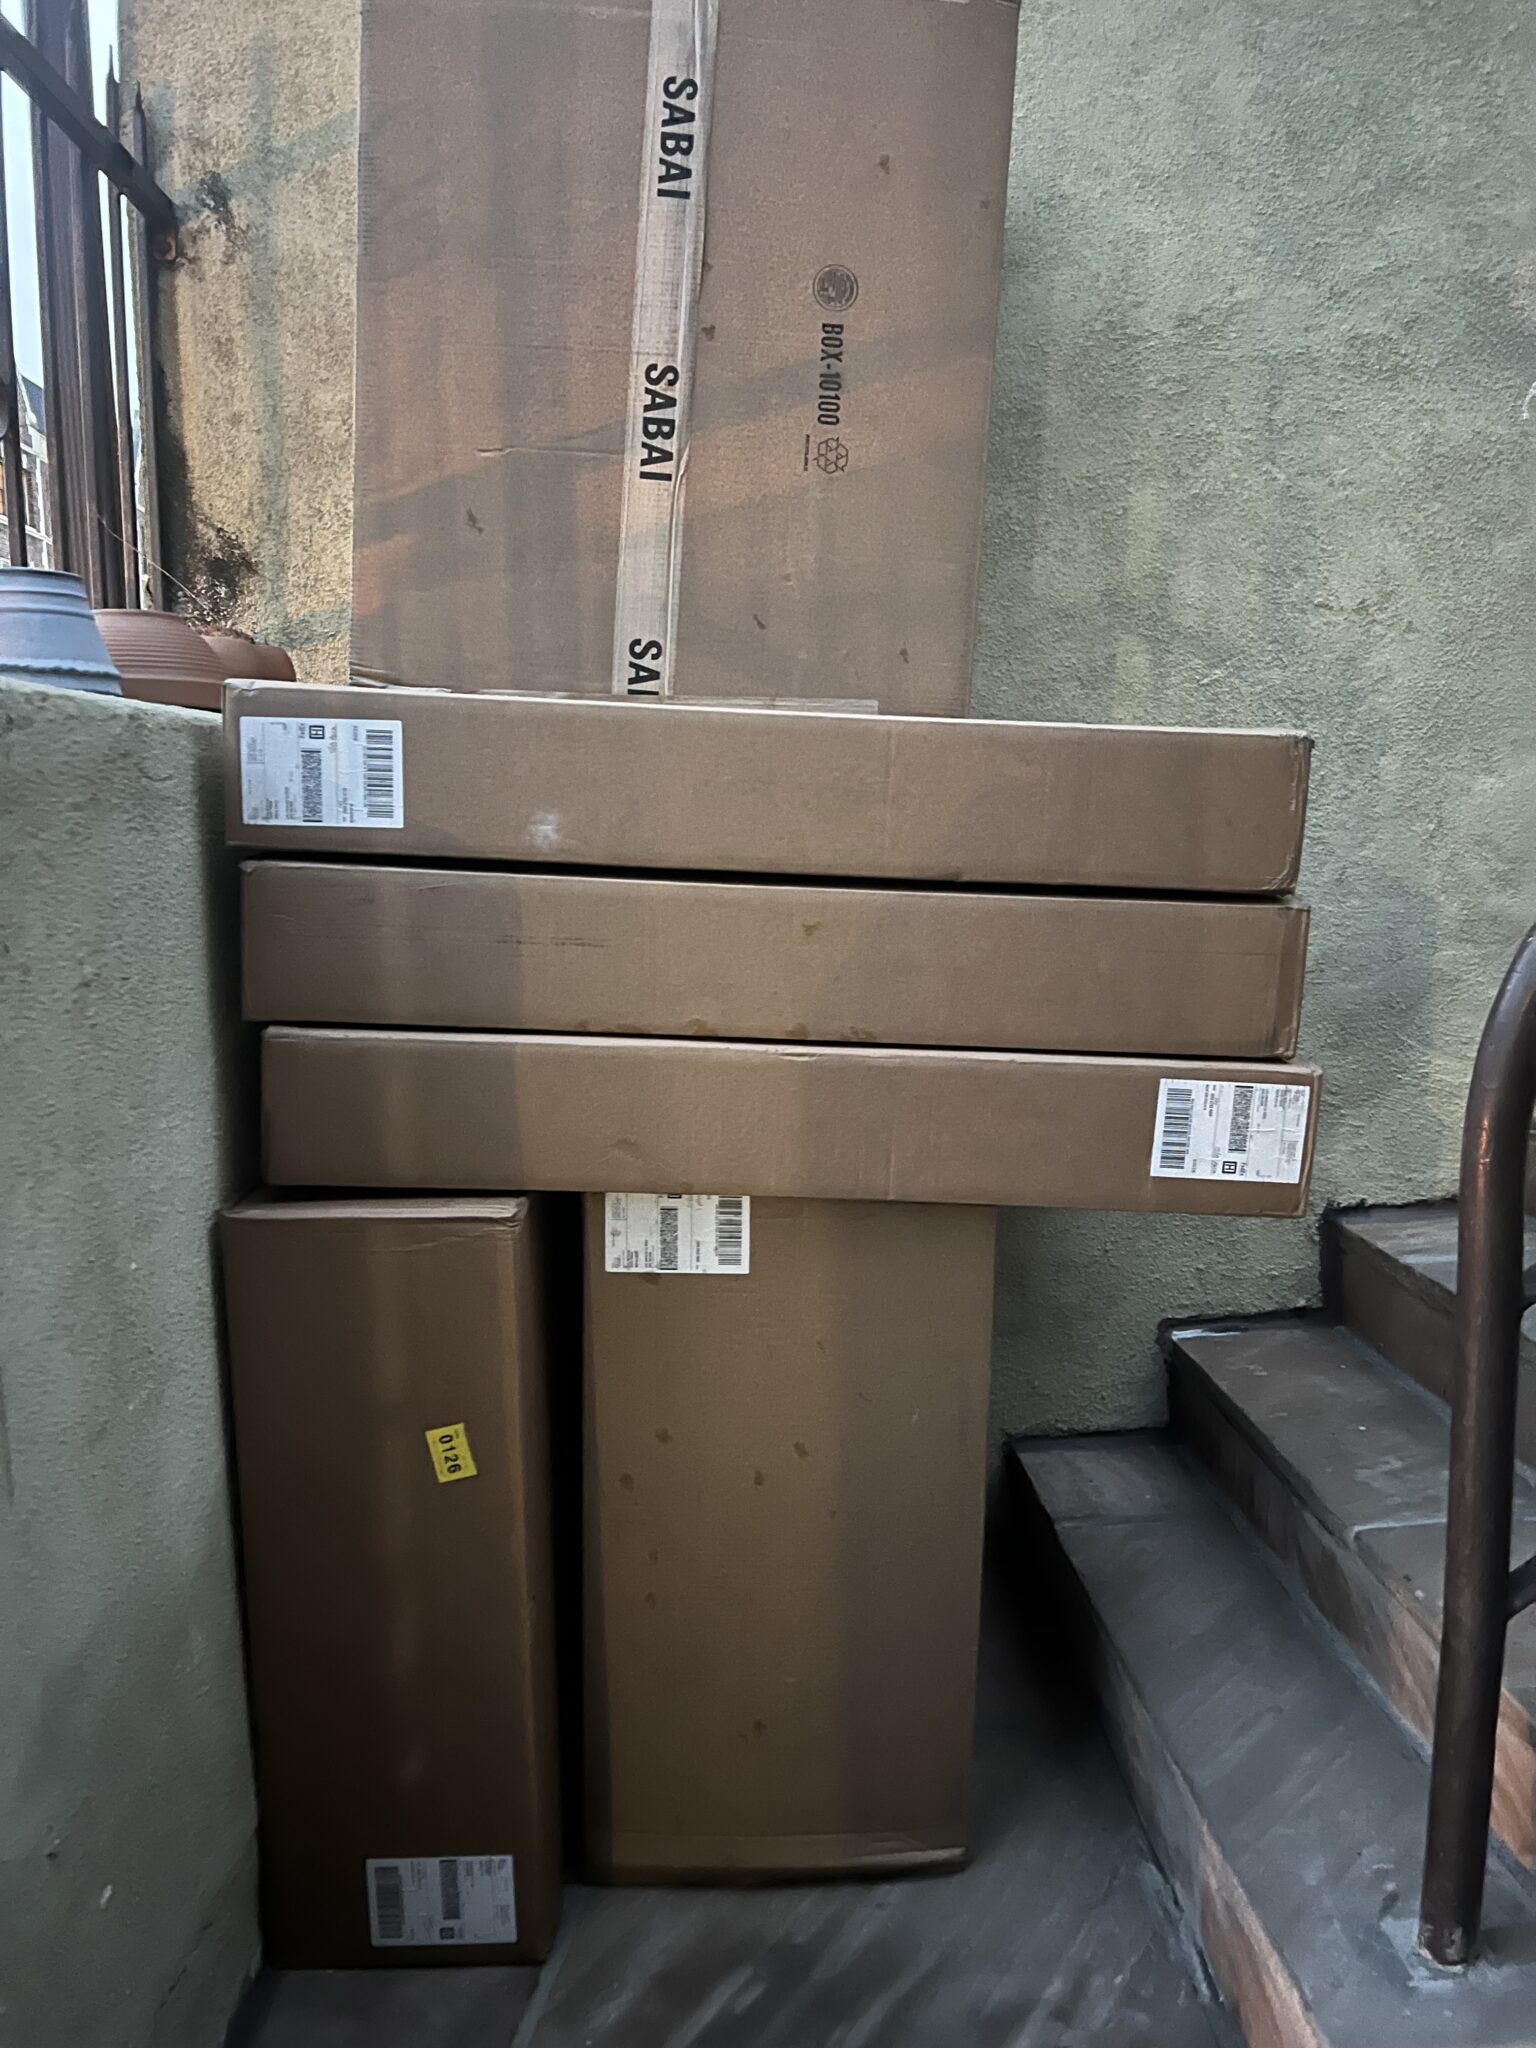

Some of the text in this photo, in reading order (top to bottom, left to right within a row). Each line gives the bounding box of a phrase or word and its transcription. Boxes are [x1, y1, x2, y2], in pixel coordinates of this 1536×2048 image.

[657, 75, 699, 200] SABAI
[639, 362, 680, 483] SABAI
[627, 638, 663, 696] SA
[438, 1434, 462, 1474] 0126
